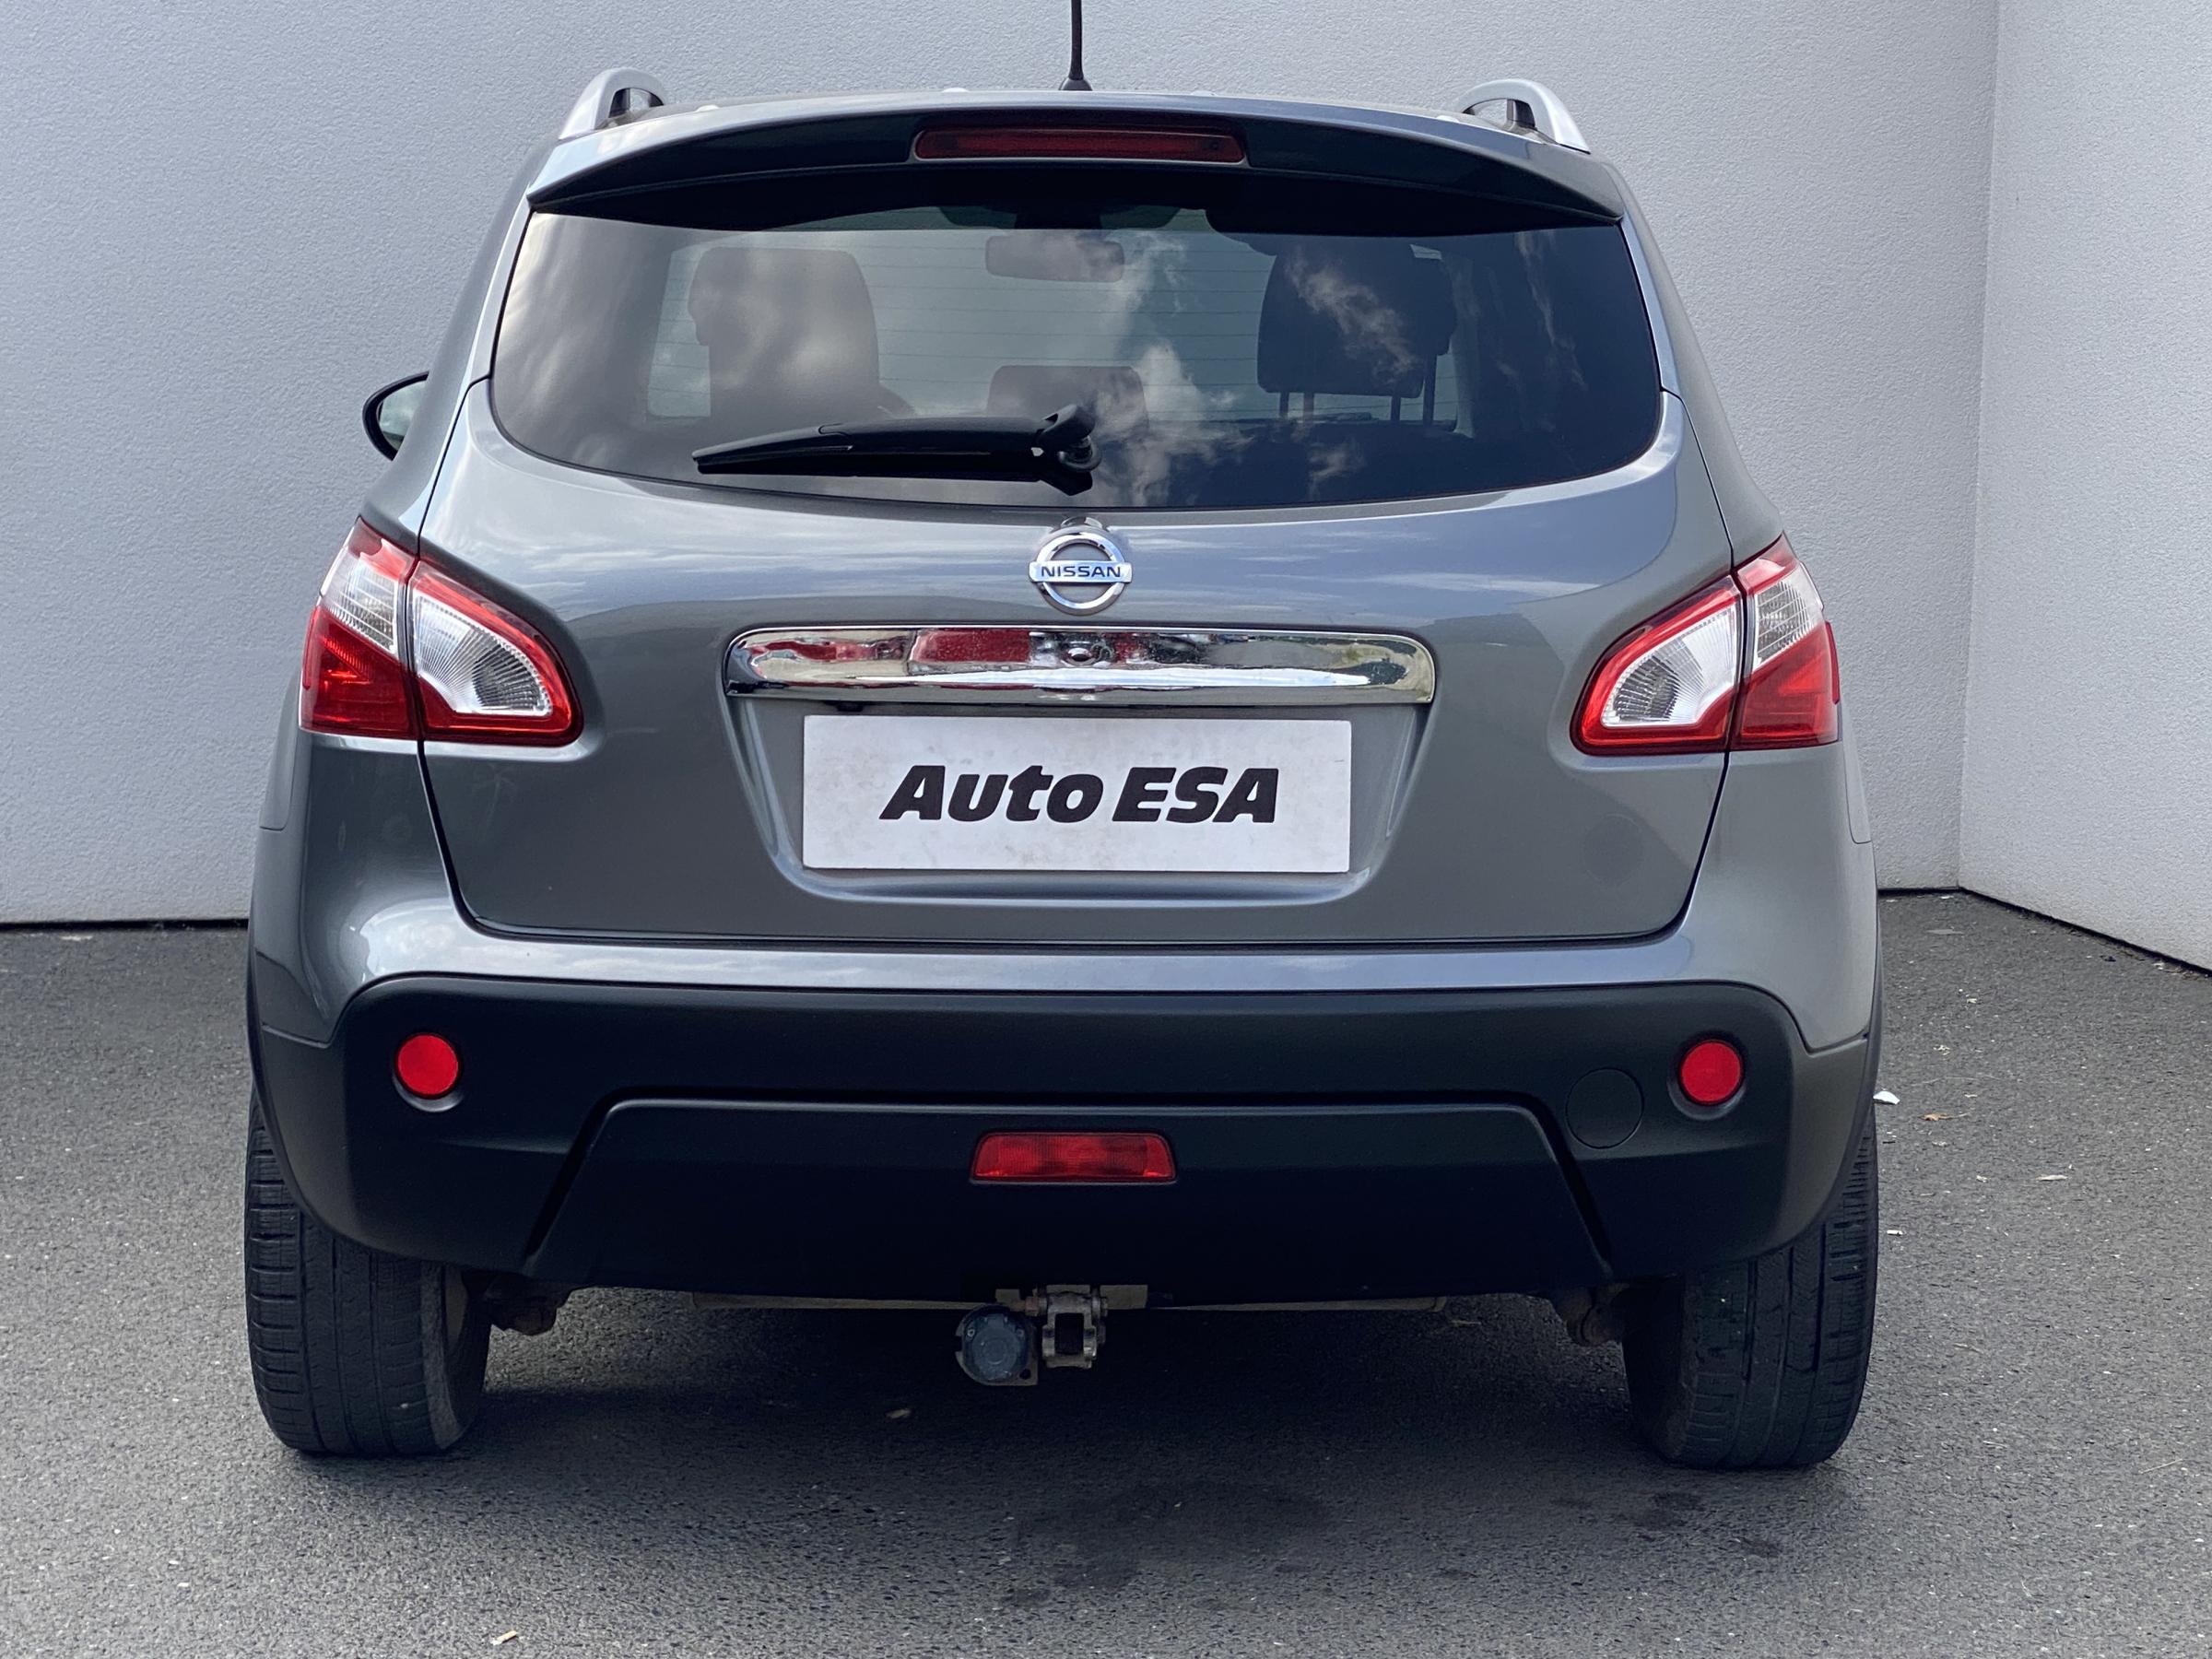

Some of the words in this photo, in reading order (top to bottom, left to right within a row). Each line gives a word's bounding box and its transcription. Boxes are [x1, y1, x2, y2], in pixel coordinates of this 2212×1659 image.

[1041, 566, 1121, 578] NISSAN
[878, 765, 1103, 823] Auto
[1112, 767, 1279, 823] ESA
